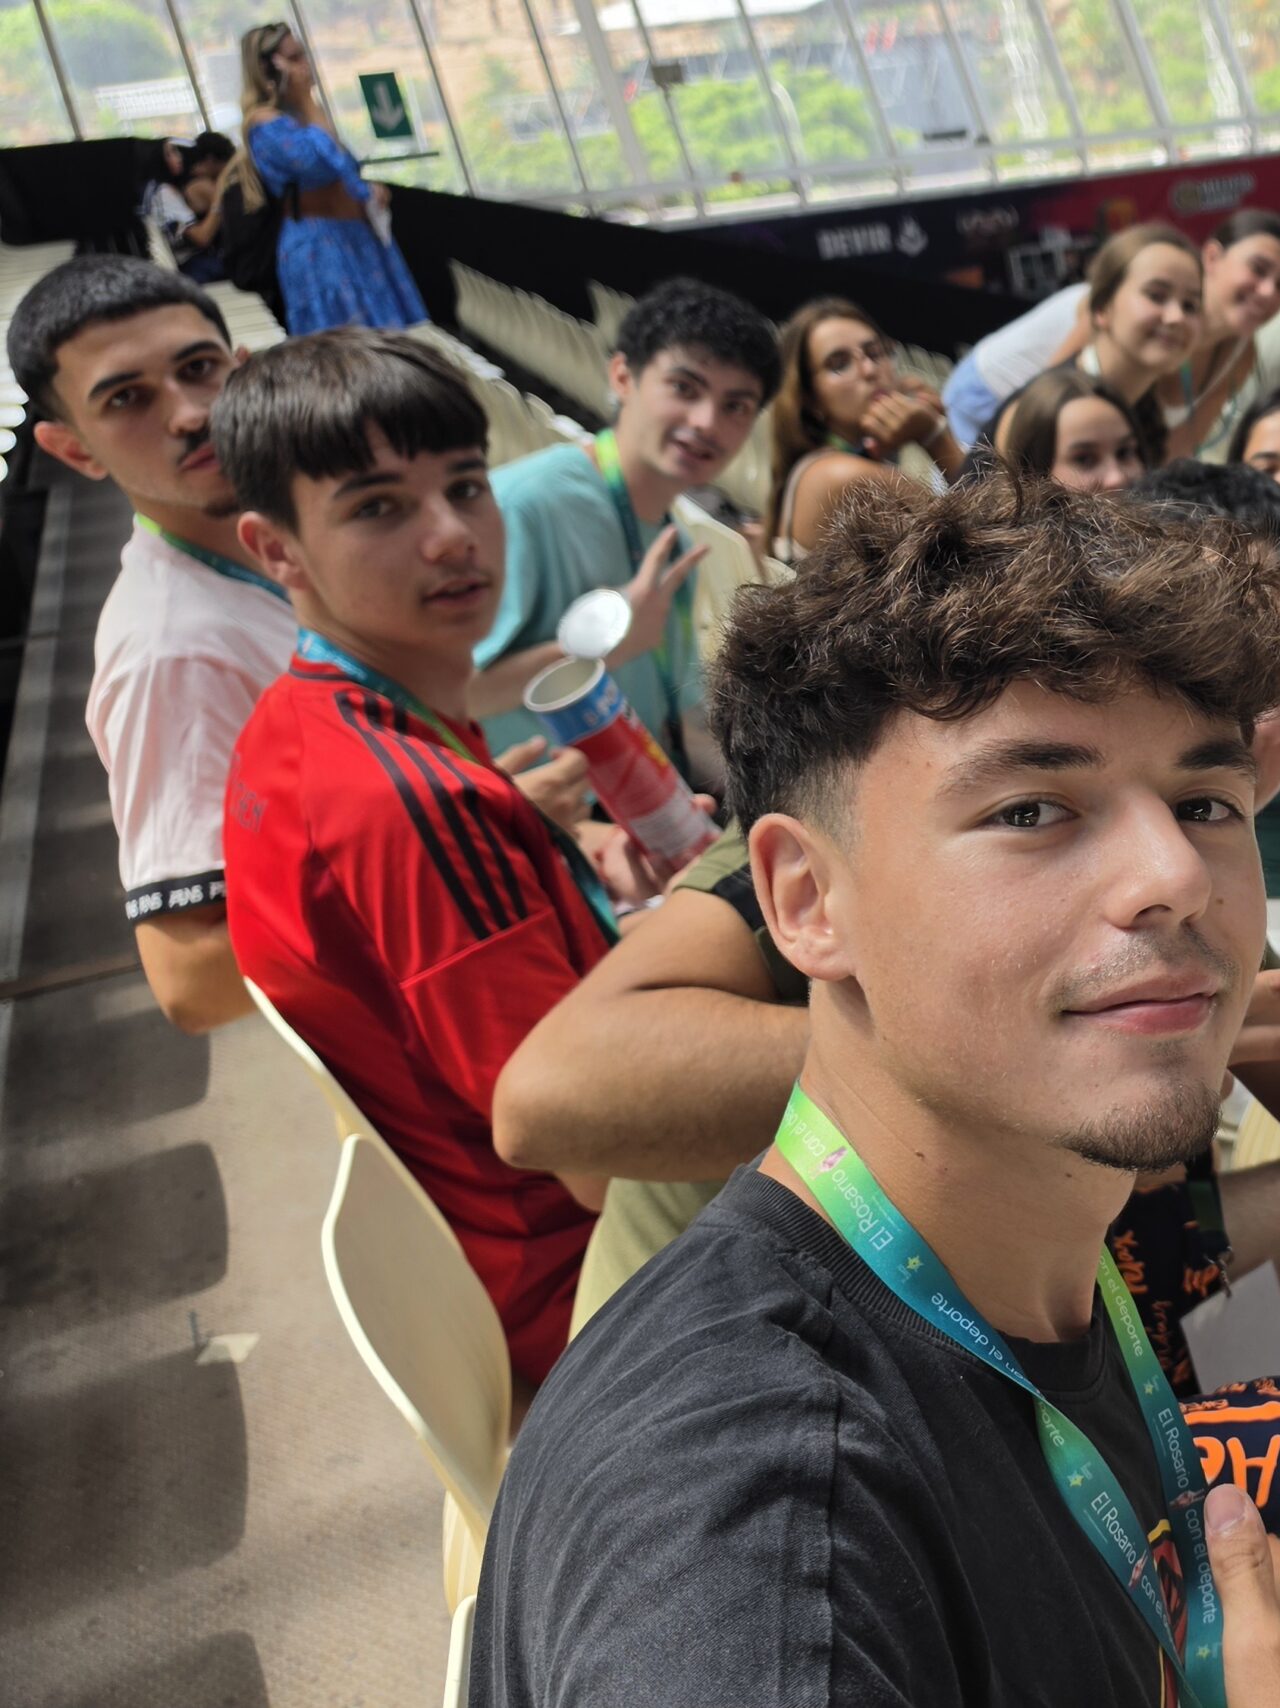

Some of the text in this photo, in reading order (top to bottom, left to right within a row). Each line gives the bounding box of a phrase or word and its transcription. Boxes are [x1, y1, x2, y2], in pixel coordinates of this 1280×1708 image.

[802, 1134, 826, 1158] con
[831, 1168, 880, 1234] Rosario
[868, 1226, 895, 1251] El
[931, 1292, 989, 1346] deporte
[1107, 1278, 1120, 1293] el
[1115, 1295, 1143, 1357] deporte
[988, 1345, 1003, 1361] el
[1158, 1408, 1174, 1428] El
[1165, 1427, 1189, 1489] Rosario
[1185, 1508, 1202, 1541] con
[1090, 1491, 1112, 1515] El
[1102, 1507, 1137, 1565] Rosario
[1141, 1575, 1157, 1605] con
[1194, 1542, 1207, 1559] el
[1198, 1561, 1218, 1624] deporte
